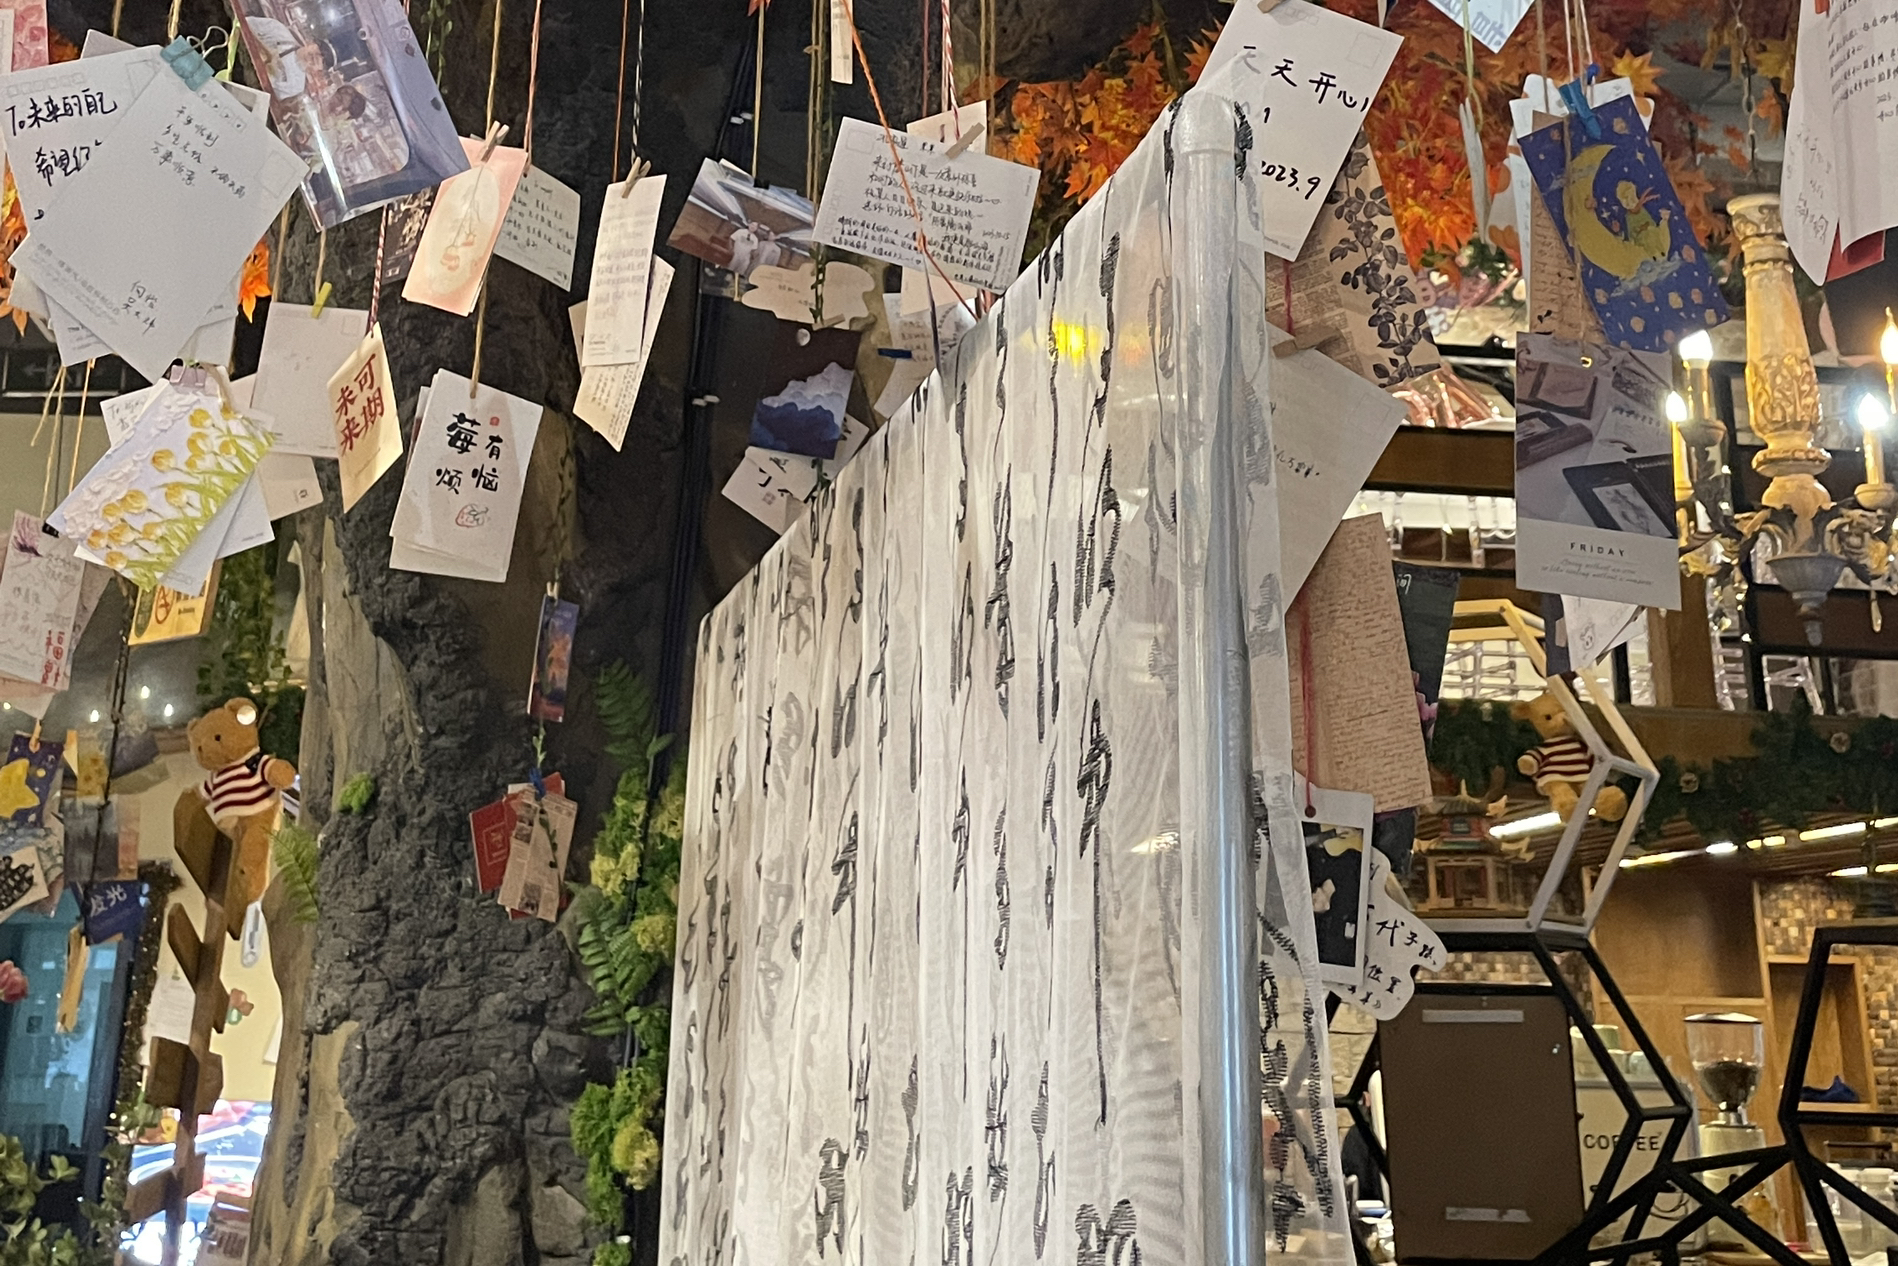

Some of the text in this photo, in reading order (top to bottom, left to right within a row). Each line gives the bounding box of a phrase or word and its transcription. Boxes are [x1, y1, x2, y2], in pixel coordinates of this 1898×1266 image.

[446, 412, 503, 461] 莓有
[436, 464, 499, 495] 烦恼
[1570, 542, 1624, 557] FRIDAY
[1583, 1134, 1659, 1151] COEE
